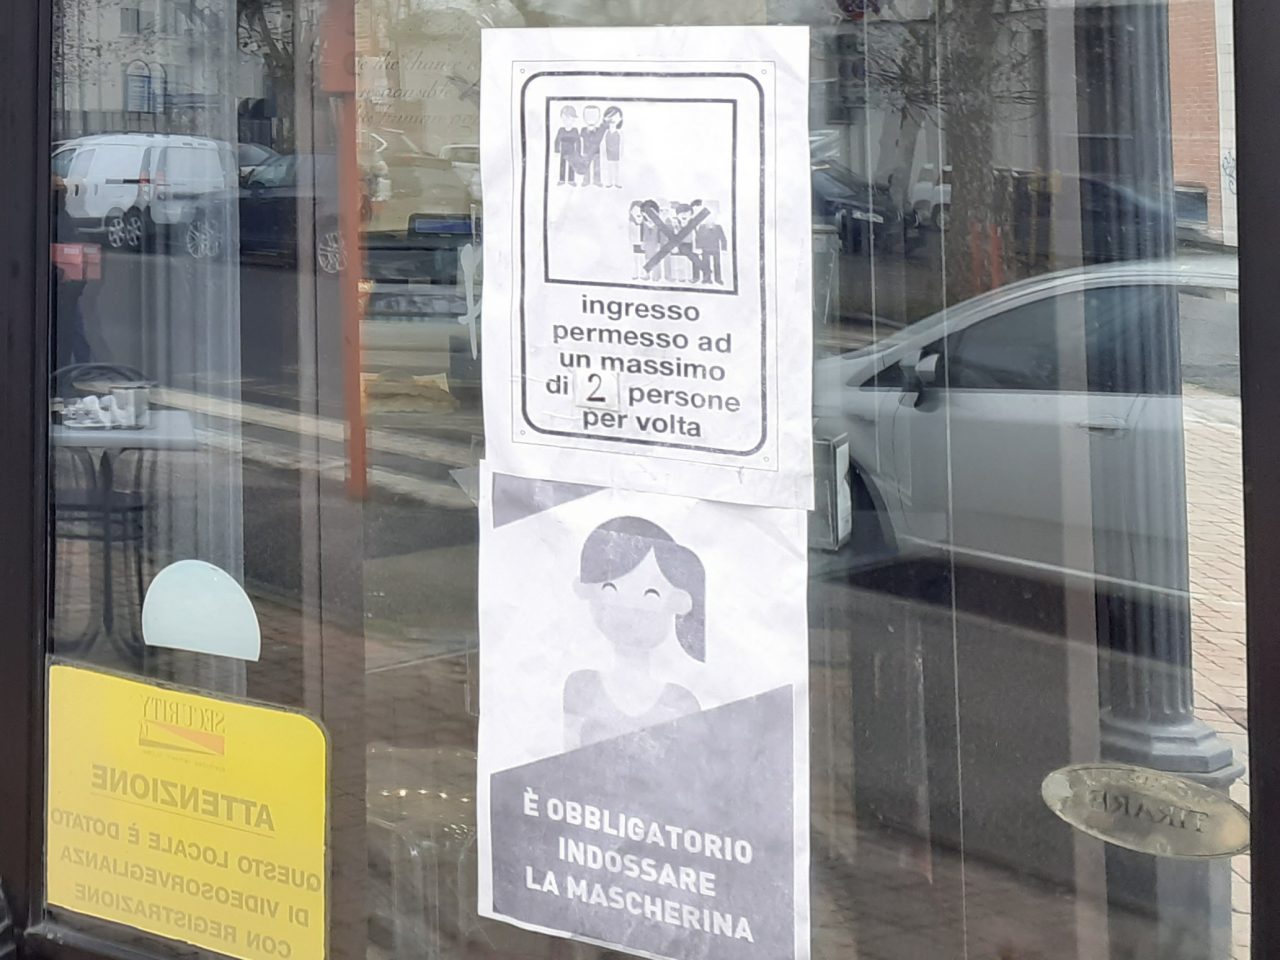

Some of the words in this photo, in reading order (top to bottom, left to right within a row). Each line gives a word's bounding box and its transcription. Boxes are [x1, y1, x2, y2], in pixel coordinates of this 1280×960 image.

[582, 294, 700, 322] ingresso
[552, 324, 689, 350] permesso
[698, 333, 732, 354] ad
[559, 351, 591, 369] un
[601, 355, 726, 382] massimo
[546, 374, 569, 396] di
[586, 373, 606, 402] 2
[628, 385, 741, 413] persone
[582, 409, 627, 431] per
[635, 415, 702, 438] volta
[523, 786, 540, 817] È
[547, 798, 753, 864] OBBLIGATORIO
[558, 836, 716, 897] INDOSSARE
[525, 865, 559, 896] LA
[567, 875, 754, 943] MASCHERINA
